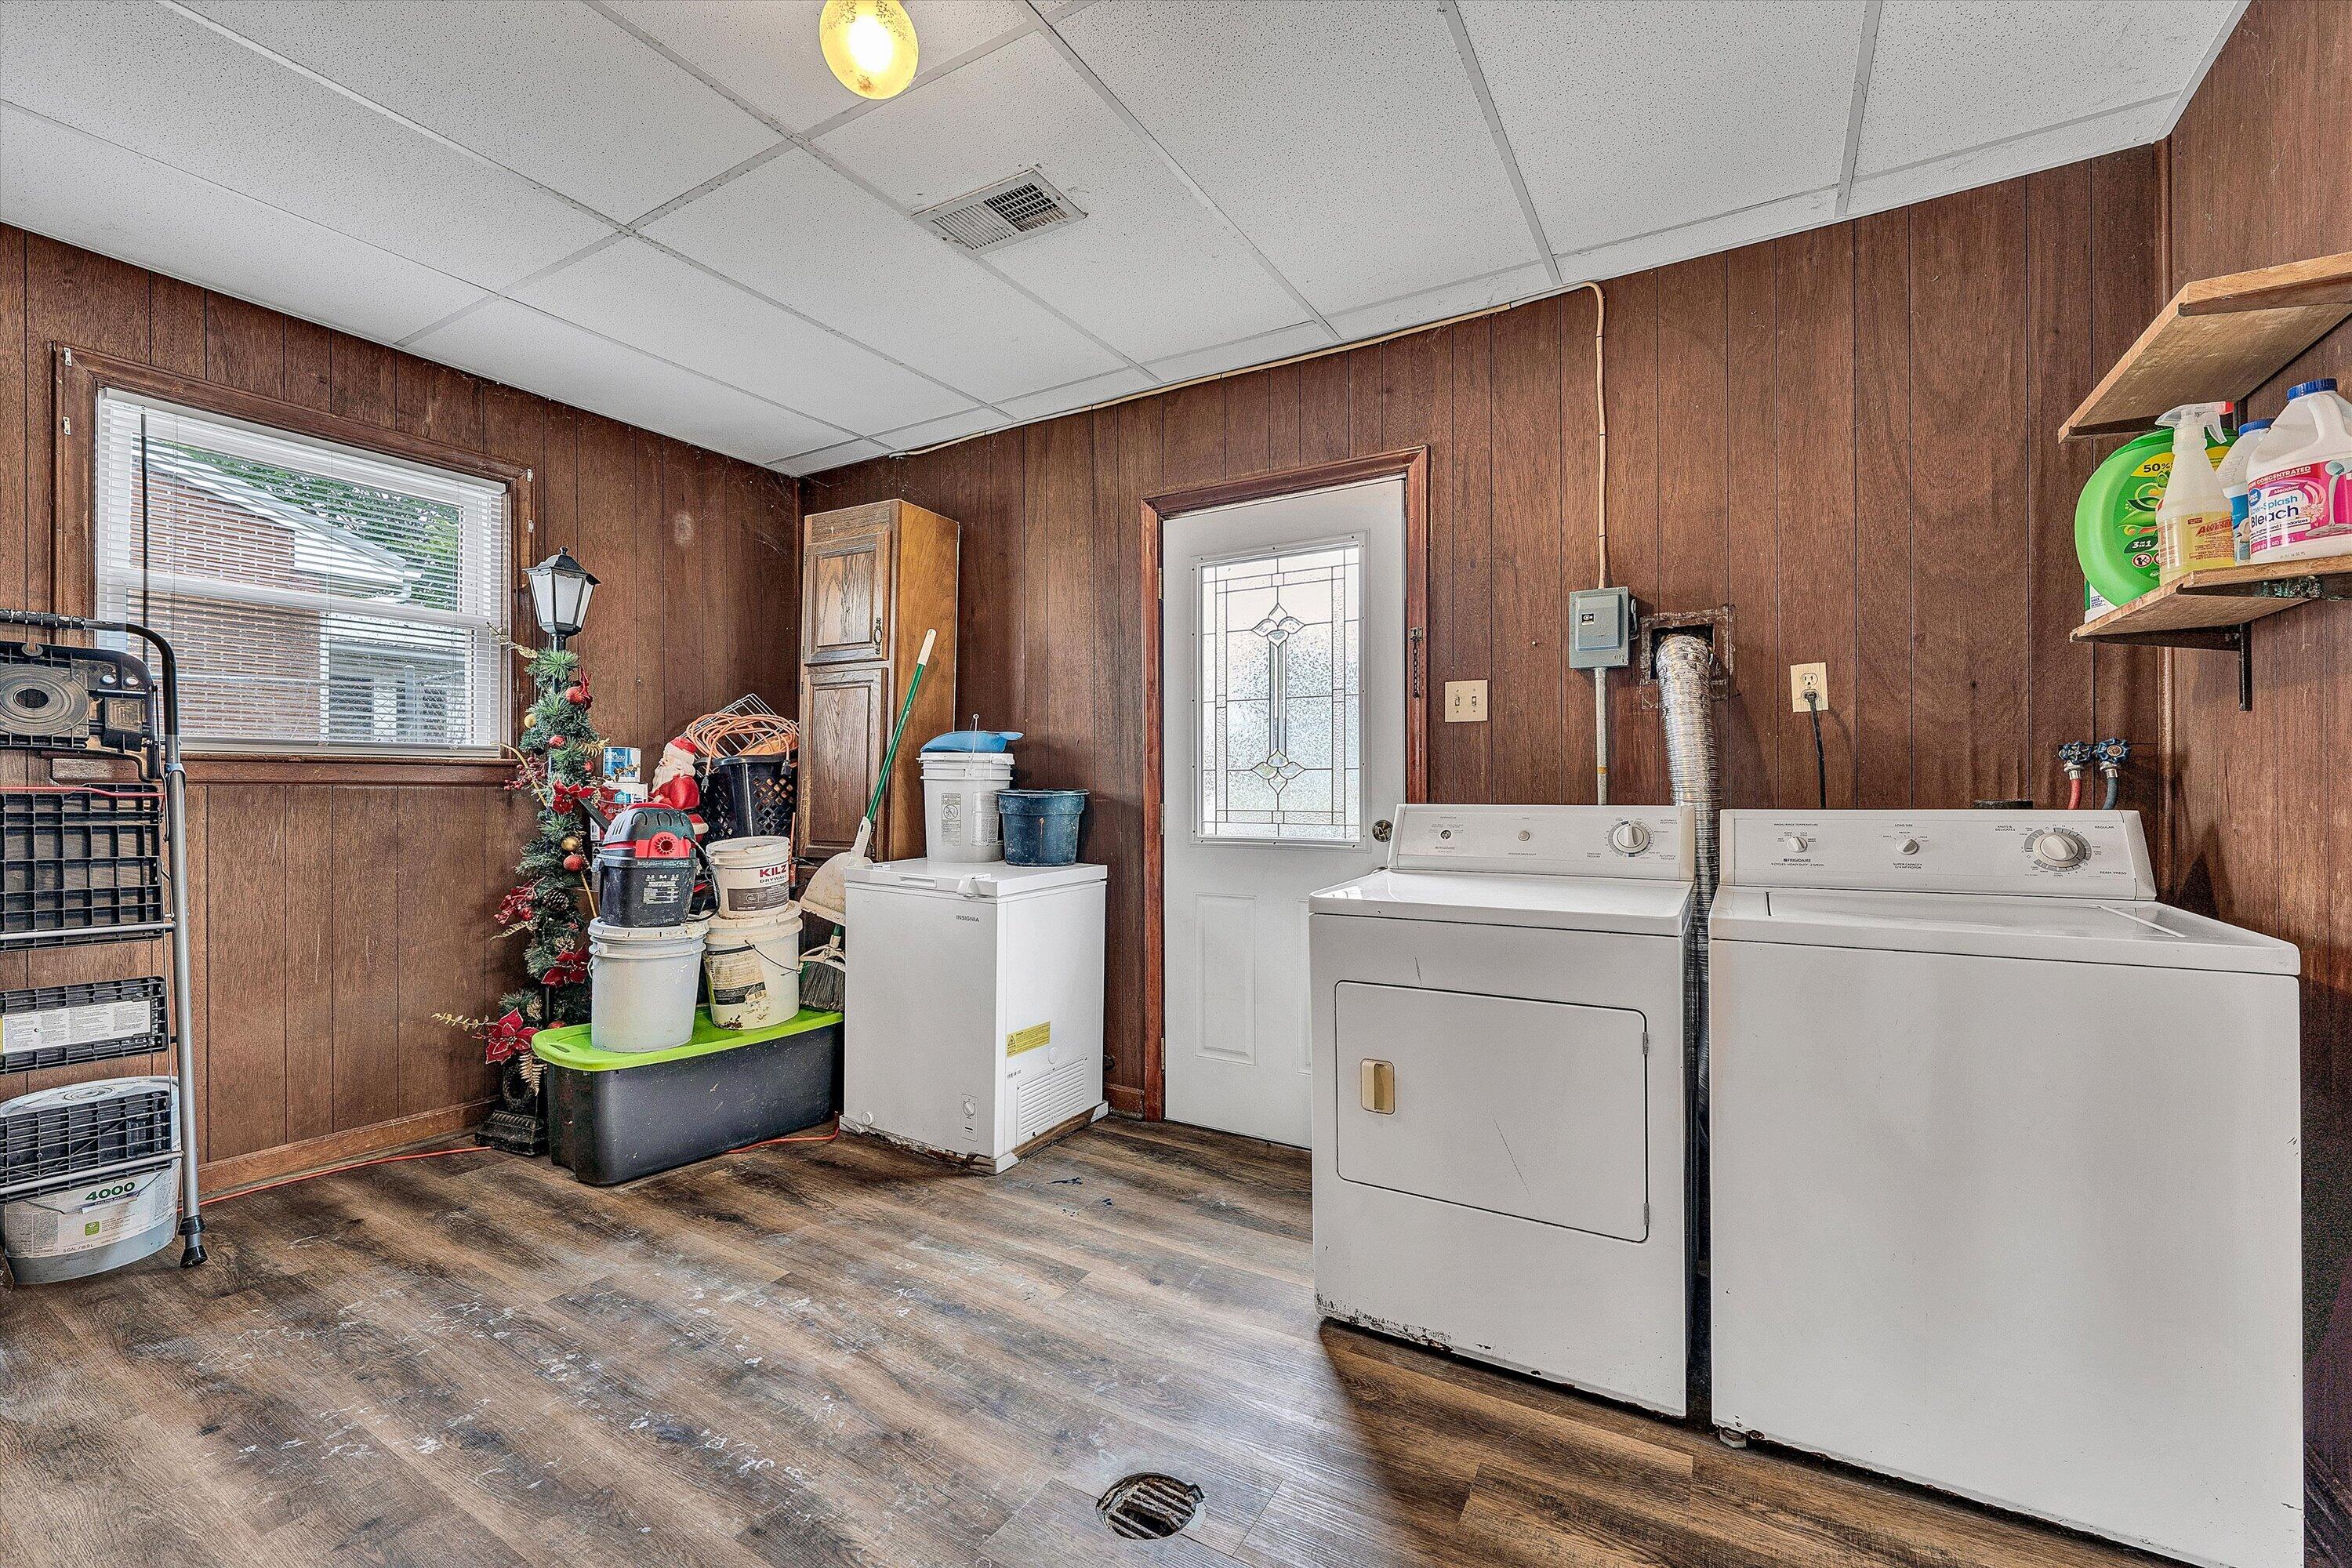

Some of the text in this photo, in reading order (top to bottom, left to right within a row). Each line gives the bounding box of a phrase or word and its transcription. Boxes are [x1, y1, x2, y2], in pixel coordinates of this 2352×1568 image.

[2143, 463, 2171, 473] 50%
[2256, 466, 2311, 485] CONCENTRATED
[2274, 485, 2299, 495] Meadow
[2251, 506, 2299, 528] Bleach
[759, 863, 787, 878] KILZ
[759, 875, 787, 884] DRYWALL
[956, 914, 980, 923] INSIGNIA
[85, 1181, 136, 1201] 4000
